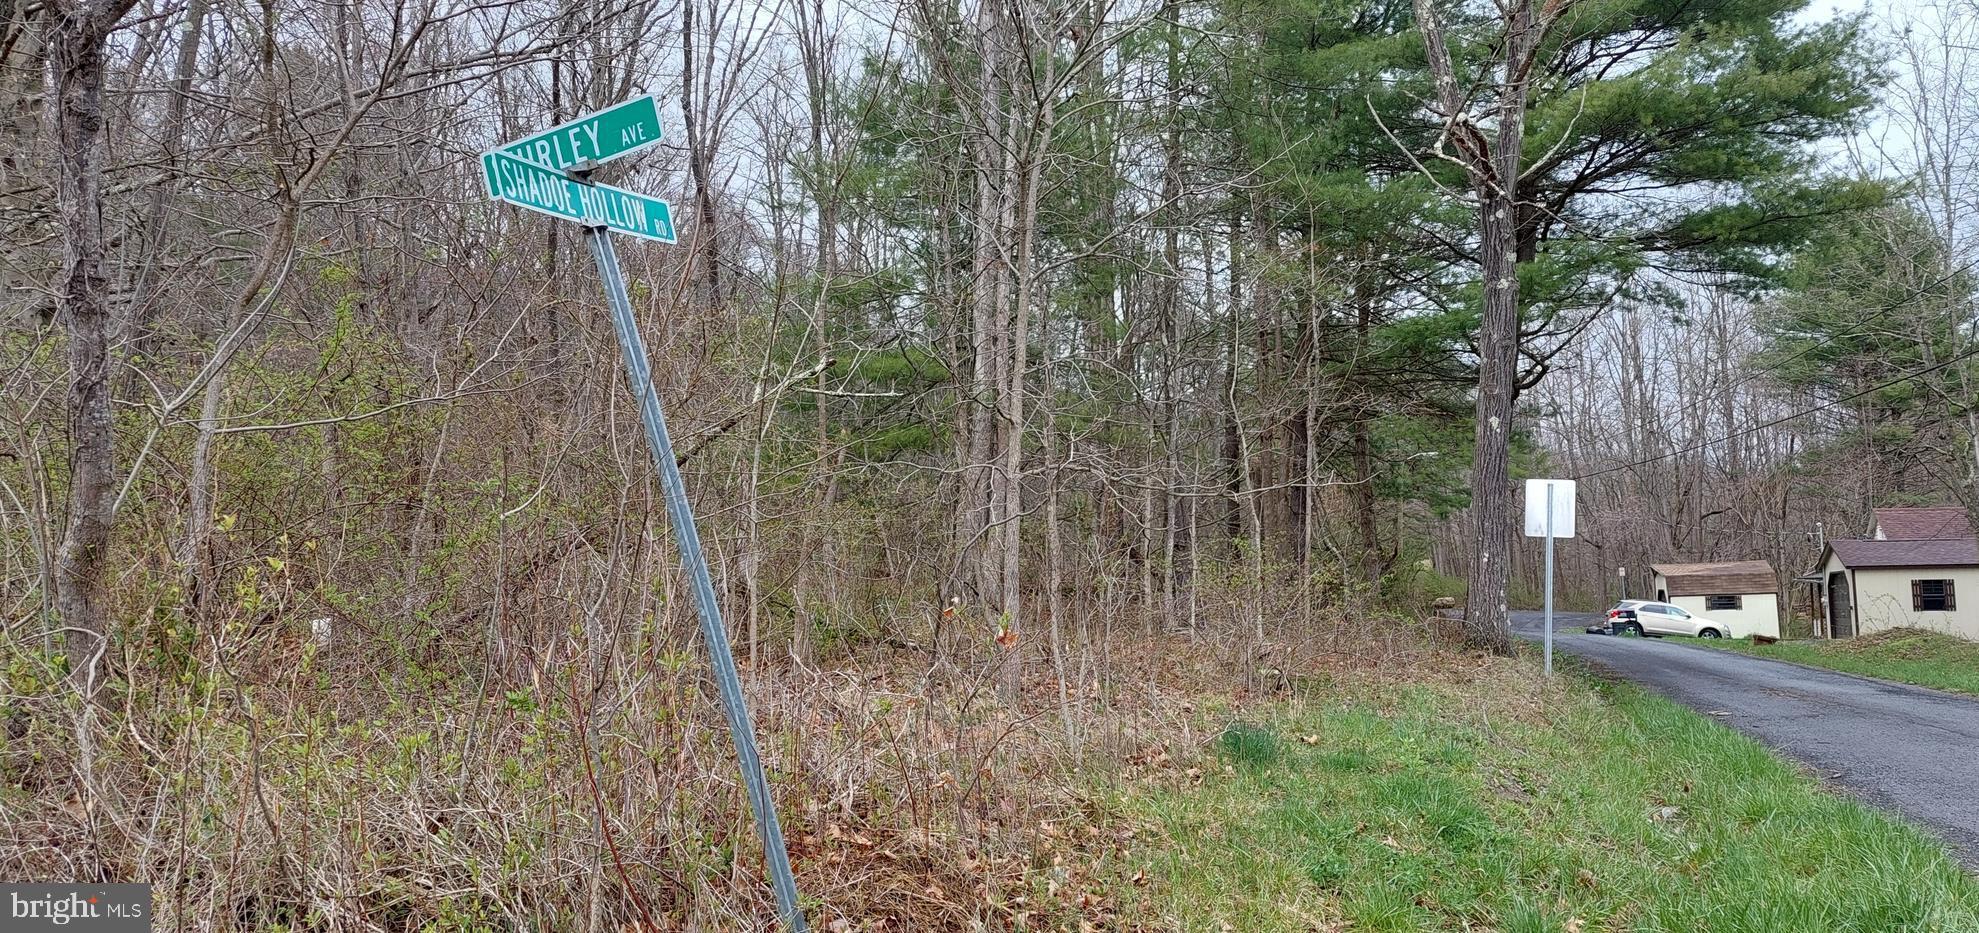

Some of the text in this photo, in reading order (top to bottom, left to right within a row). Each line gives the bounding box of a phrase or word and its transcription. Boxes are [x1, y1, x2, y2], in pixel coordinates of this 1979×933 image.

[501, 158, 667, 236] SHADOE HOLLOW RD
